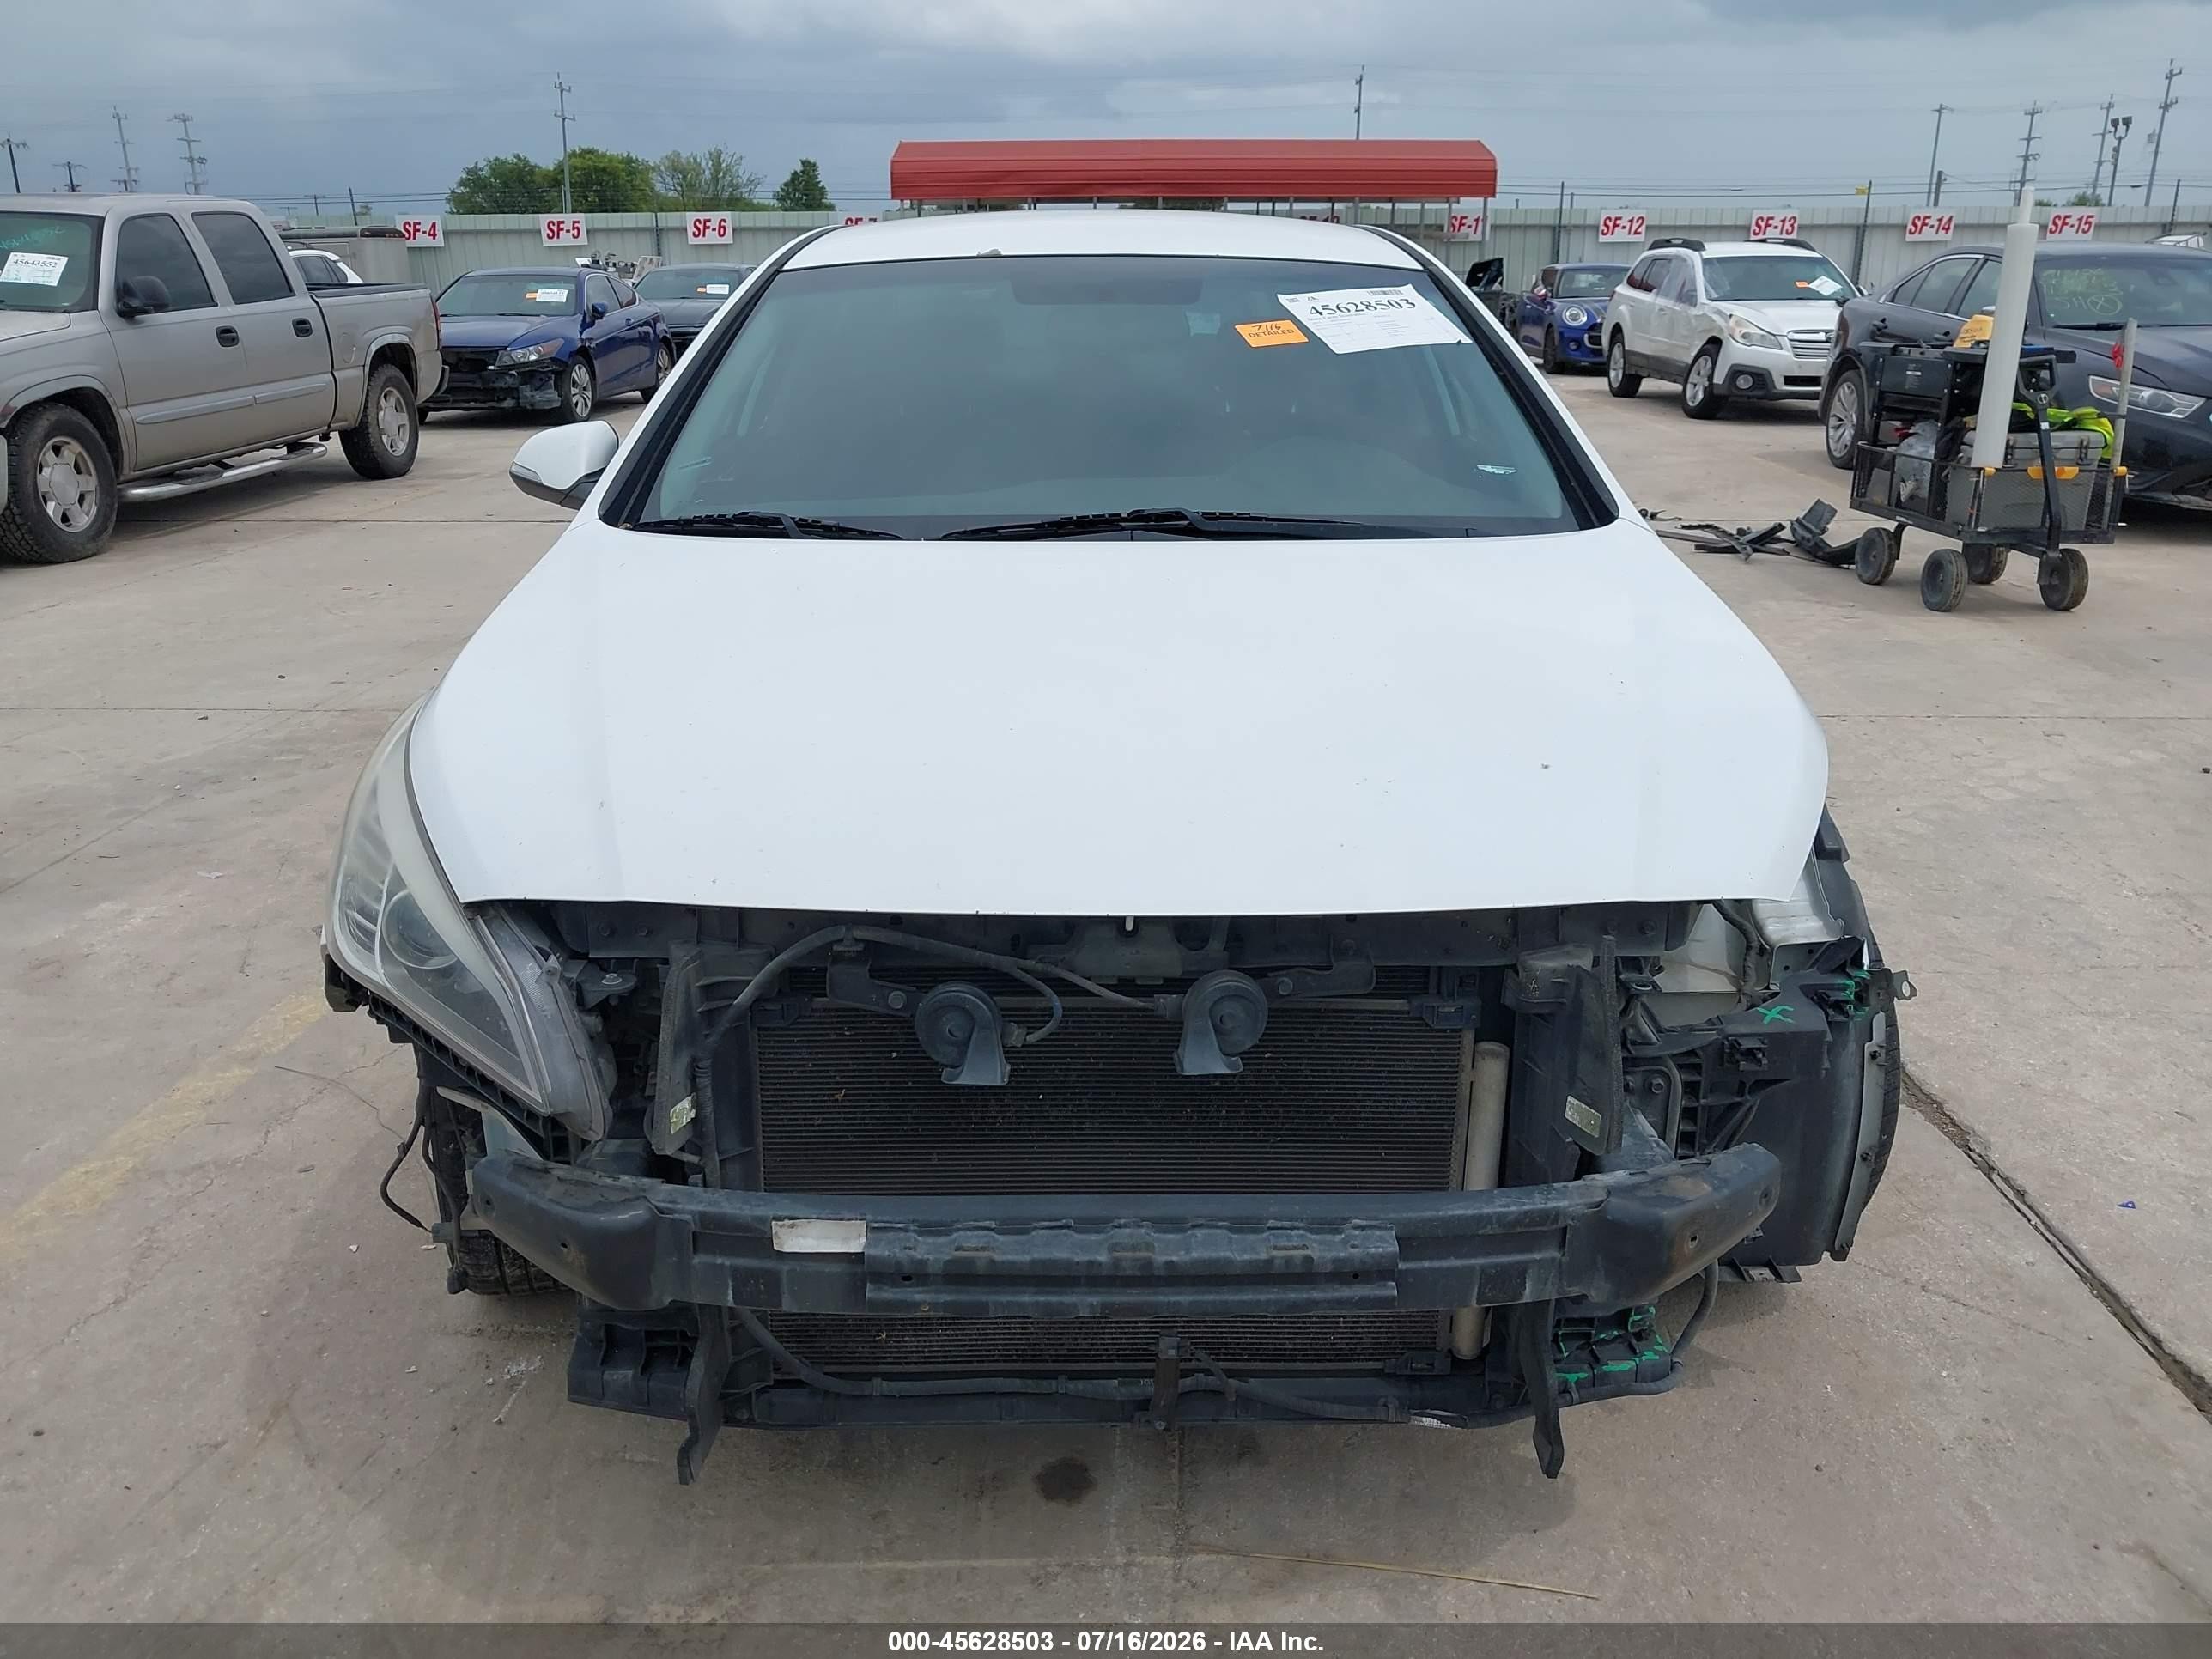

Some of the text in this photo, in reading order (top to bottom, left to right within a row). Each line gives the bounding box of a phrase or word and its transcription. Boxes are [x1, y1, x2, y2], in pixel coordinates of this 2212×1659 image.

[403, 221, 437, 240] SF-4
[546, 220, 580, 240] SF-5
[692, 217, 727, 238] SF-6
[1450, 215, 1486, 234] SF-1
[1601, 216, 1645, 236] SF-12
[1752, 216, 1797, 236] SF-13
[1908, 215, 1954, 235] SF-14
[2048, 215, 2095, 234] SF-15
[1310, 298, 1415, 317] 45628503
[1249, 329, 1295, 338] DETAILED
